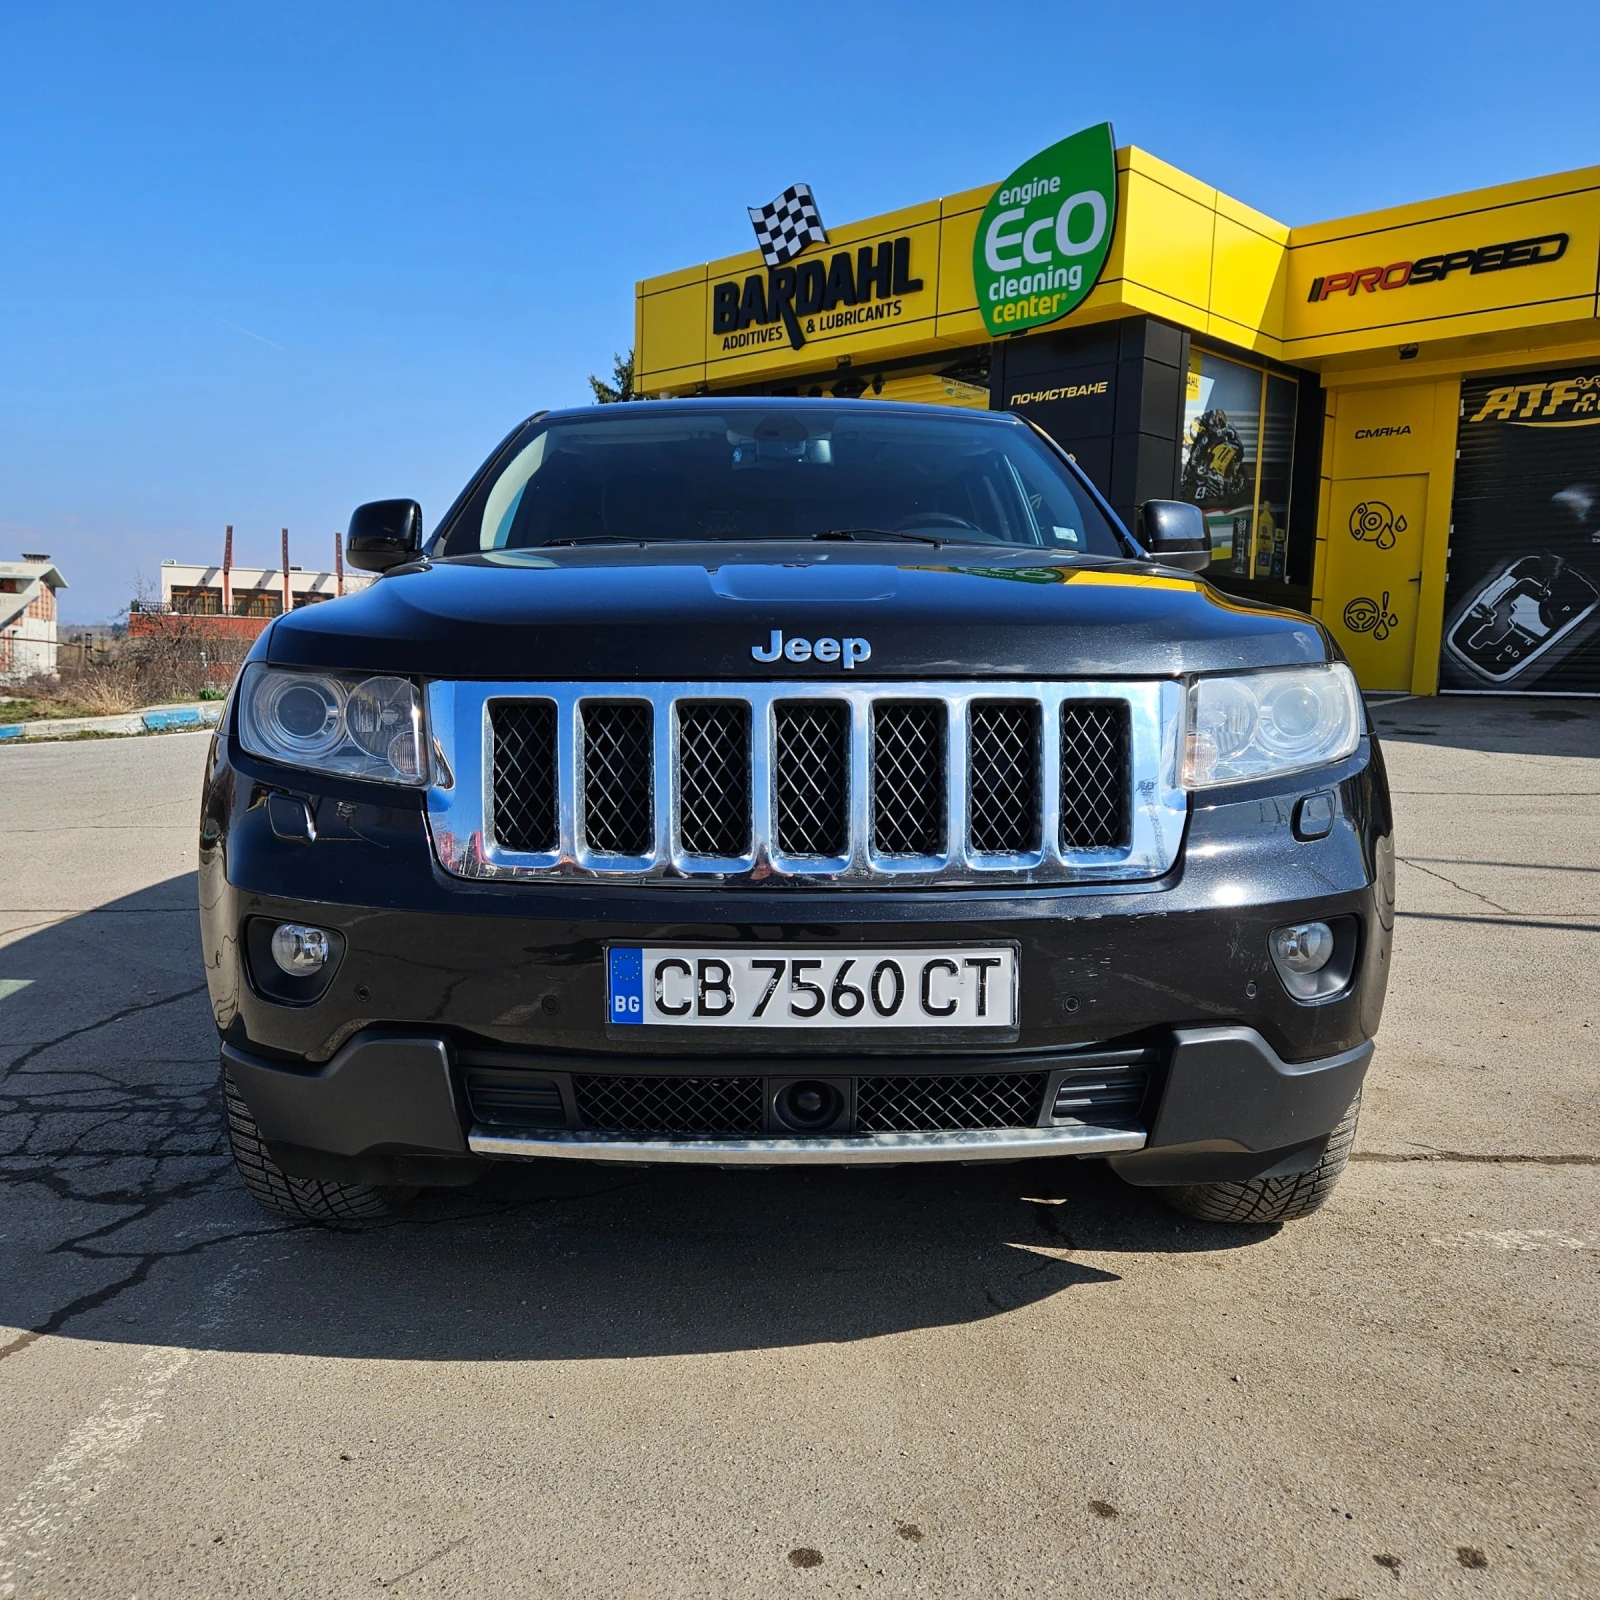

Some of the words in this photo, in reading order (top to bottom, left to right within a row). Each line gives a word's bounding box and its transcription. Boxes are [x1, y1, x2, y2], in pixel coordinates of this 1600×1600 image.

[999, 175, 1061, 206] engine
[988, 265, 1083, 301] cleaning
[1319, 232, 1569, 301] PROSPEED
[713, 236, 924, 350] BARDAHL
[722, 325, 783, 351] ADDITIVES
[806, 318, 815, 334] &
[819, 300, 902, 331] LUBRICANTS
[1010, 381, 1109, 406] ПОЧИСТВАНЕ
[1469, 379, 1578, 423] ATF
[1355, 425, 1411, 440] СМЯНА
[751, 629, 872, 670] Jeep
[614, 994, 641, 1014] BG
[653, 957, 735, 1018] CB
[750, 957, 906, 1018] 7560
[921, 956, 1002, 1017] CT
